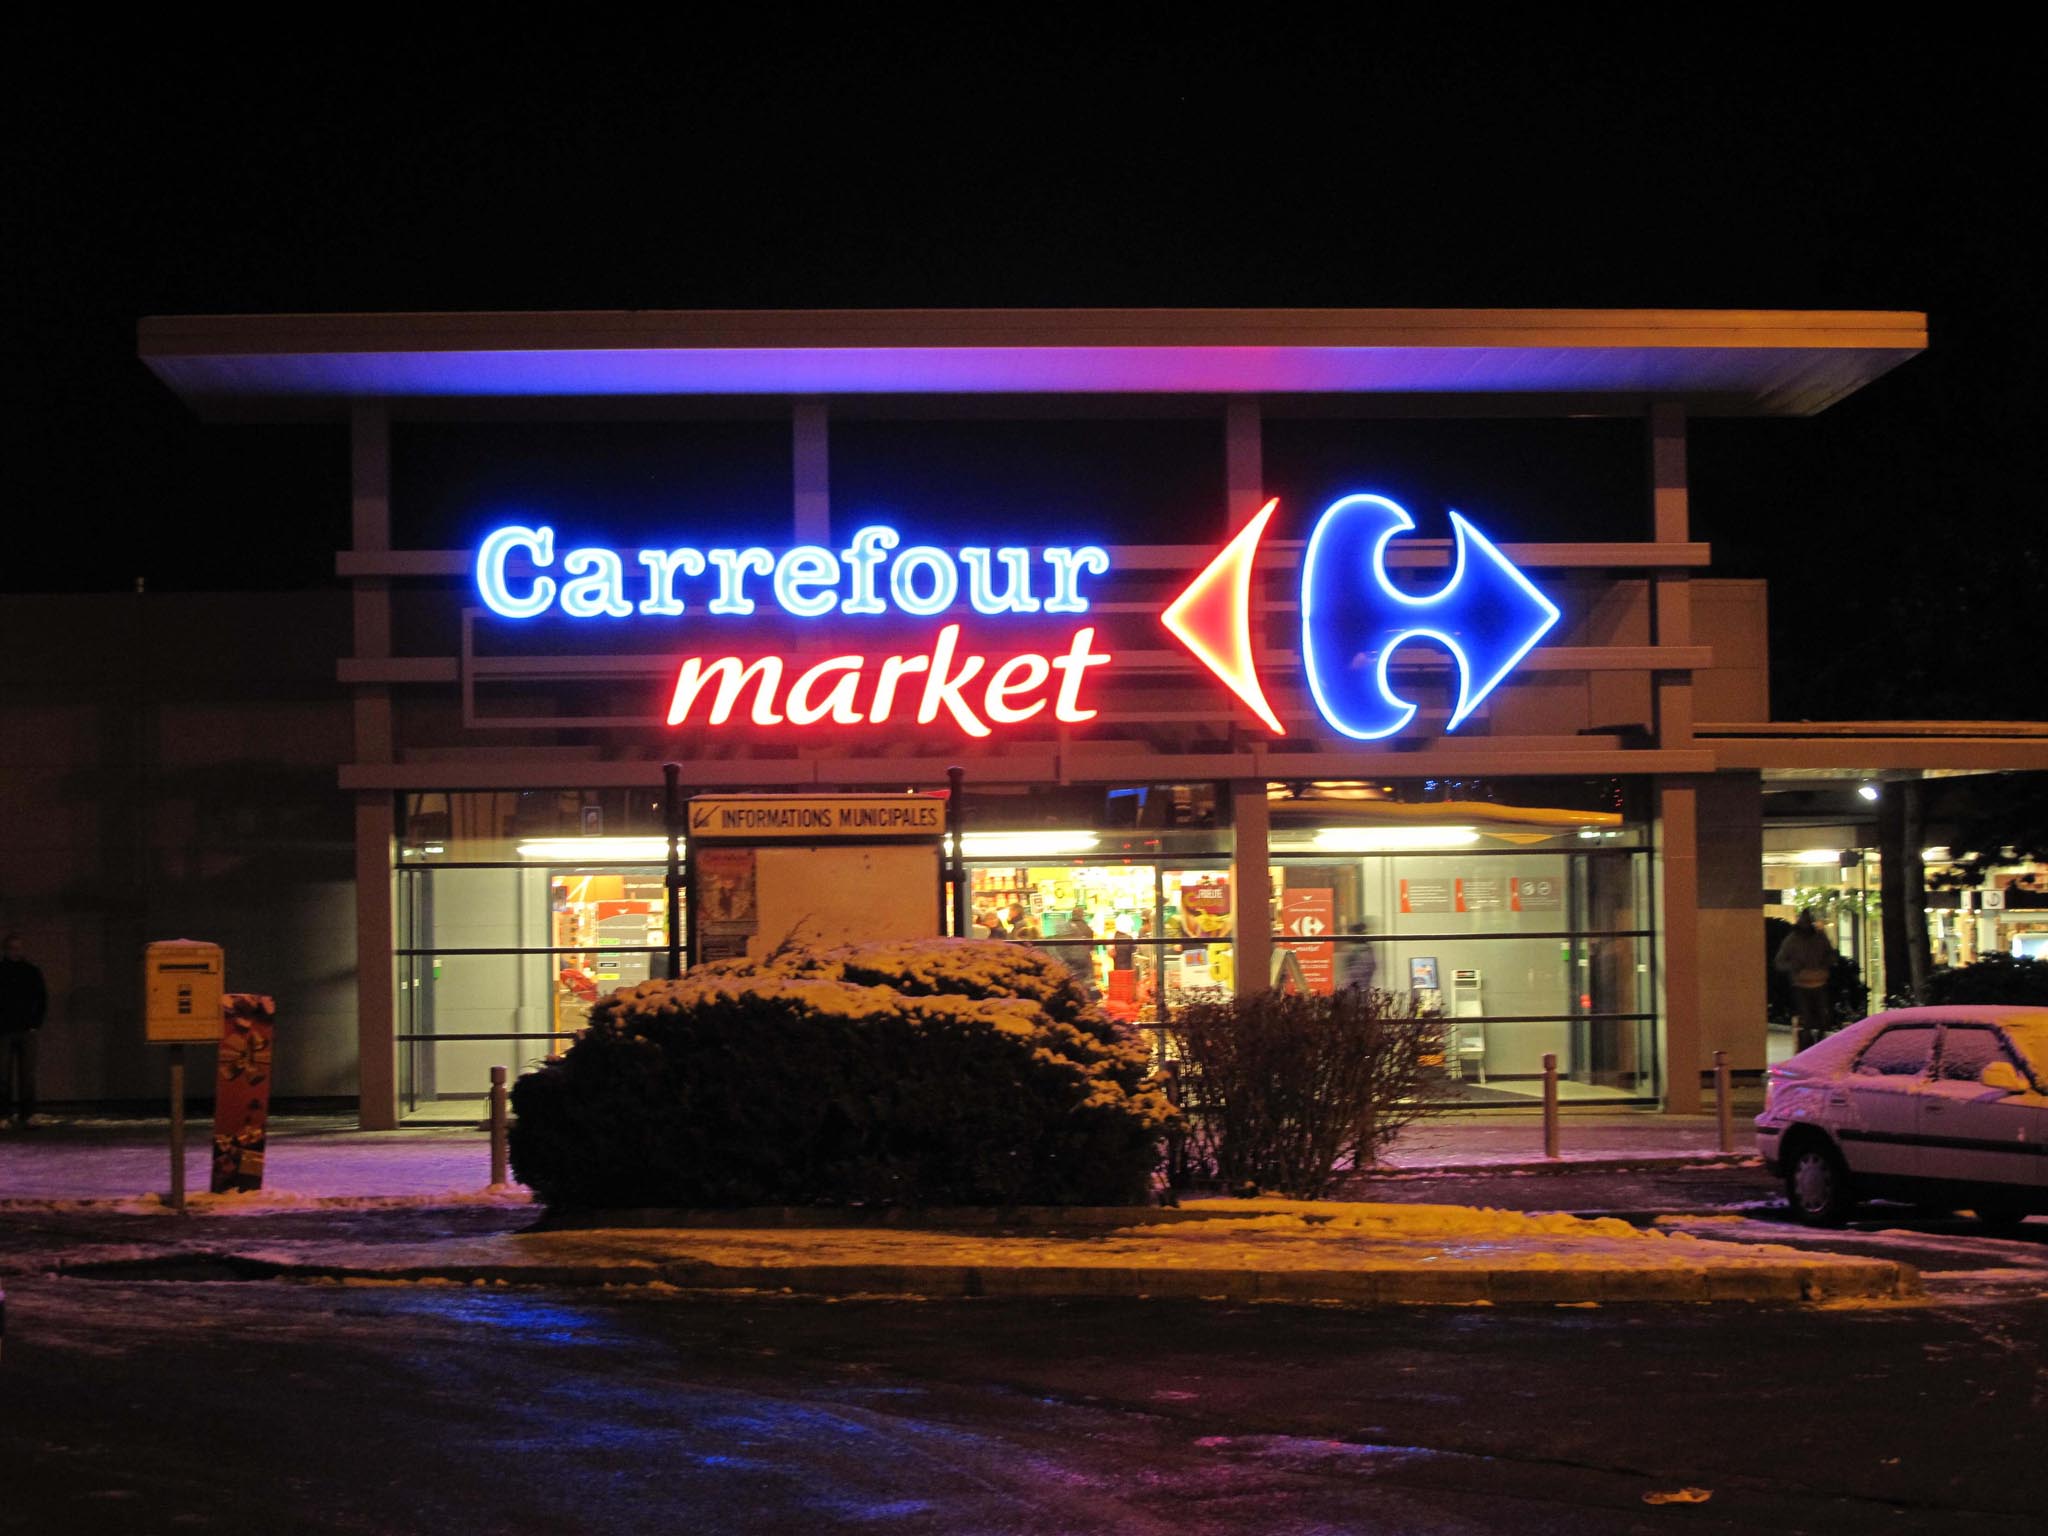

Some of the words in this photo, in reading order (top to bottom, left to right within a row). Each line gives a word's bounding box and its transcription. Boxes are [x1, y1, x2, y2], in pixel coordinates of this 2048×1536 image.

[476, 525, 1110, 618] Carrefour
[667, 624, 1111, 737] market
[721, 808, 832, 829] INFORMATIONS
[839, 807, 938, 827] MUNICIPALES
